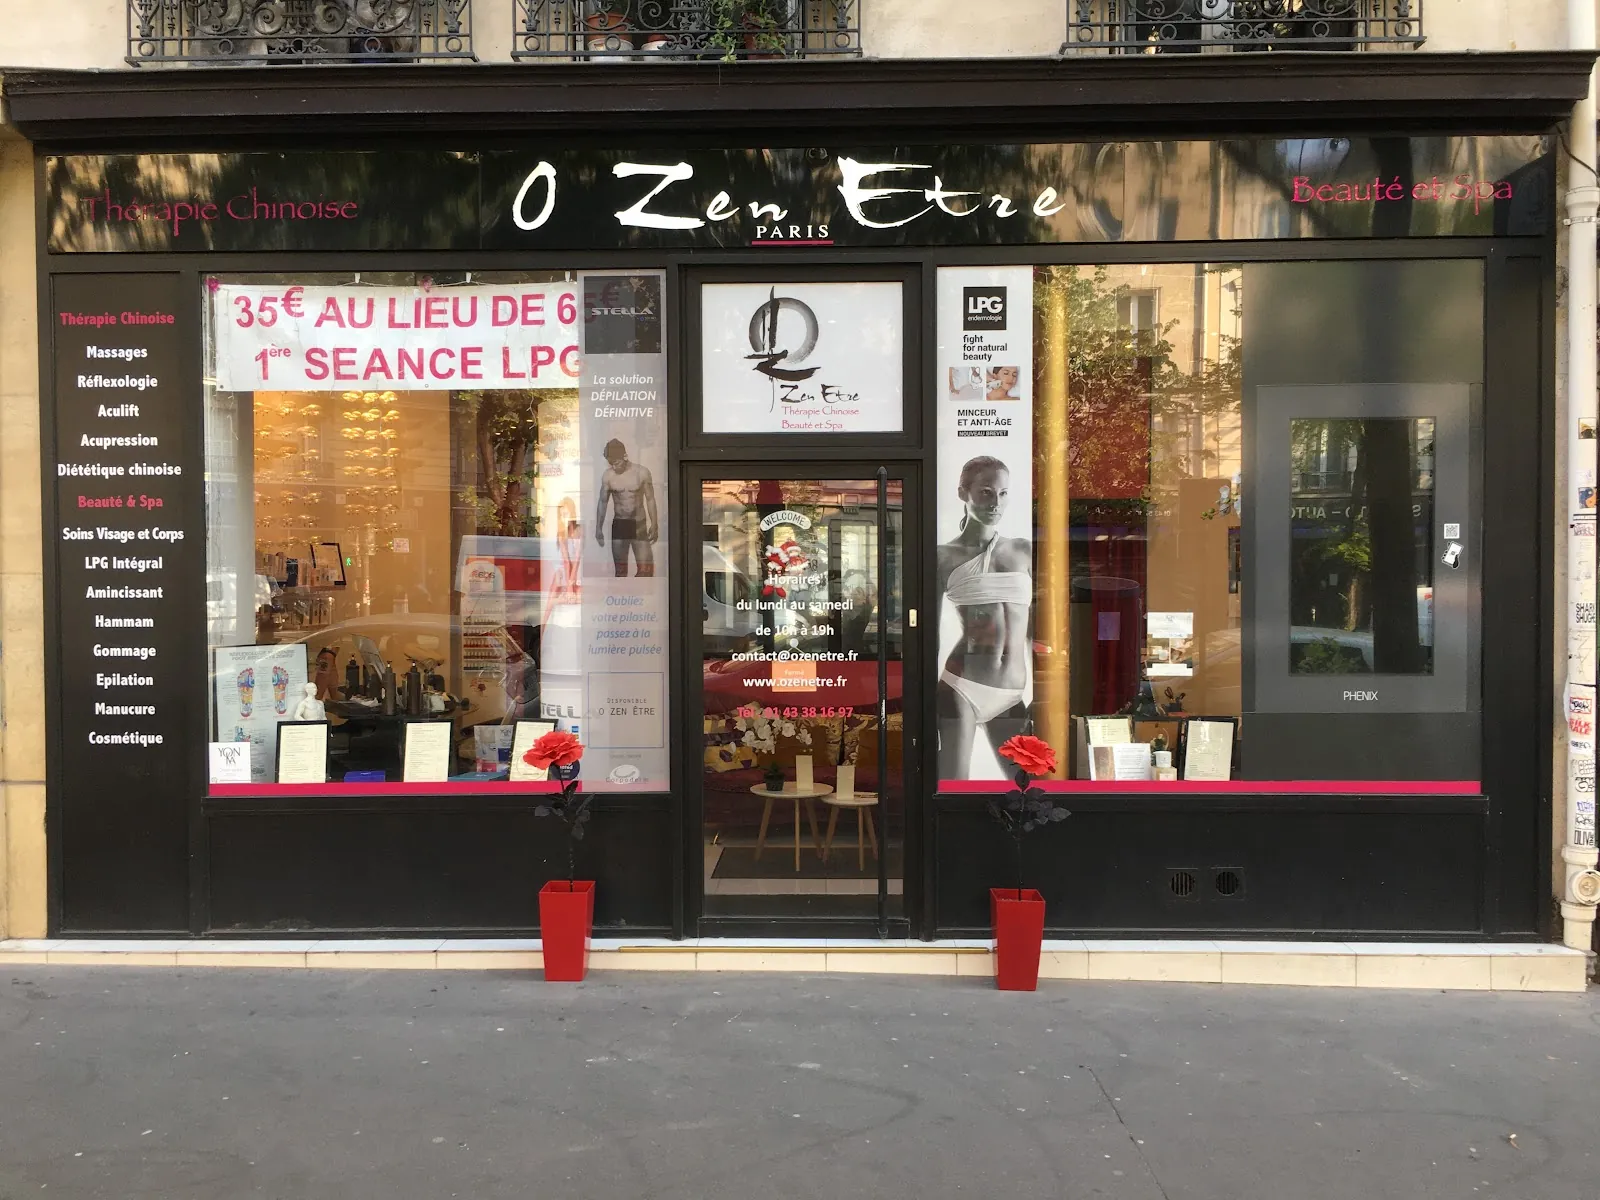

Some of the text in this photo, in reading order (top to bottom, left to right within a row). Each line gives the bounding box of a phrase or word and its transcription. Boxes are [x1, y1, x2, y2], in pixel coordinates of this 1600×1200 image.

[512, 156, 1066, 231] O Zen Etre
[1291, 174, 1513, 216] Beauté et Spa
[83, 186, 358, 237] Thérapie Chinoise
[755, 224, 830, 240] PARIS
[233, 286, 305, 329] 35€
[313, 296, 373, 329] AU
[387, 296, 478, 329] LIEU
[491, 294, 545, 328] DE
[591, 307, 654, 316] STELLA
[968, 297, 1003, 314] LPG
[60, 311, 175, 328] Thérapie Chinoise
[963, 335, 983, 343] fight
[86, 345, 148, 361] Massages
[963, 343, 1008, 352] for natural
[254, 344, 588, 381] 1ère SEANCE LPG
[963, 352, 992, 361] beauty
[77, 374, 158, 390] Réflexologie
[593, 374, 654, 385] La solution
[590, 388, 657, 401] DÉPILATION
[780, 383, 860, 403] Zen Etre
[98, 404, 140, 417] Aculift
[594, 405, 654, 418] DÉFINITIVE
[781, 405, 860, 418] Thérapie Chinoise
[957, 409, 997, 417] MINCEUR
[781, 419, 843, 432] Beauté et Spa
[970, 416, 1012, 426] ANTI-ÂGE
[80, 433, 158, 450] Acupression
[57, 462, 182, 479] Diététique chinoise
[77, 494, 163, 510] Beauté & Spa
[763, 511, 807, 527] WELCOME
[62, 527, 184, 543] Soins Visage et Corps
[85, 556, 163, 572] LPG Intégral
[769, 573, 821, 586] Horaires
[85, 585, 163, 598] Amincissant
[605, 594, 644, 607] Oubliez
[736, 599, 853, 611] du lundi au samedi
[95, 614, 154, 628] Hammam
[592, 612, 618, 623] votre
[596, 628, 651, 640] passez à la
[756, 625, 834, 636] de 10h à 19h
[93, 644, 157, 660] Gommage
[588, 643, 662, 658] lumière pulsée
[731, 650, 858, 664] contact@ozenetre.fr
[96, 673, 154, 689] Epilation
[743, 676, 847, 687] www.ozenetre.fr
[1343, 691, 1379, 701] PHENIX
[95, 702, 156, 715] Manucure
[598, 704, 655, 716] O ZEN ÊTRE
[783, 707, 798, 718] 43
[801, 707, 816, 718] 38
[820, 707, 835, 718] 16
[838, 707, 853, 718] 97
[88, 732, 163, 747] Cosmétique
